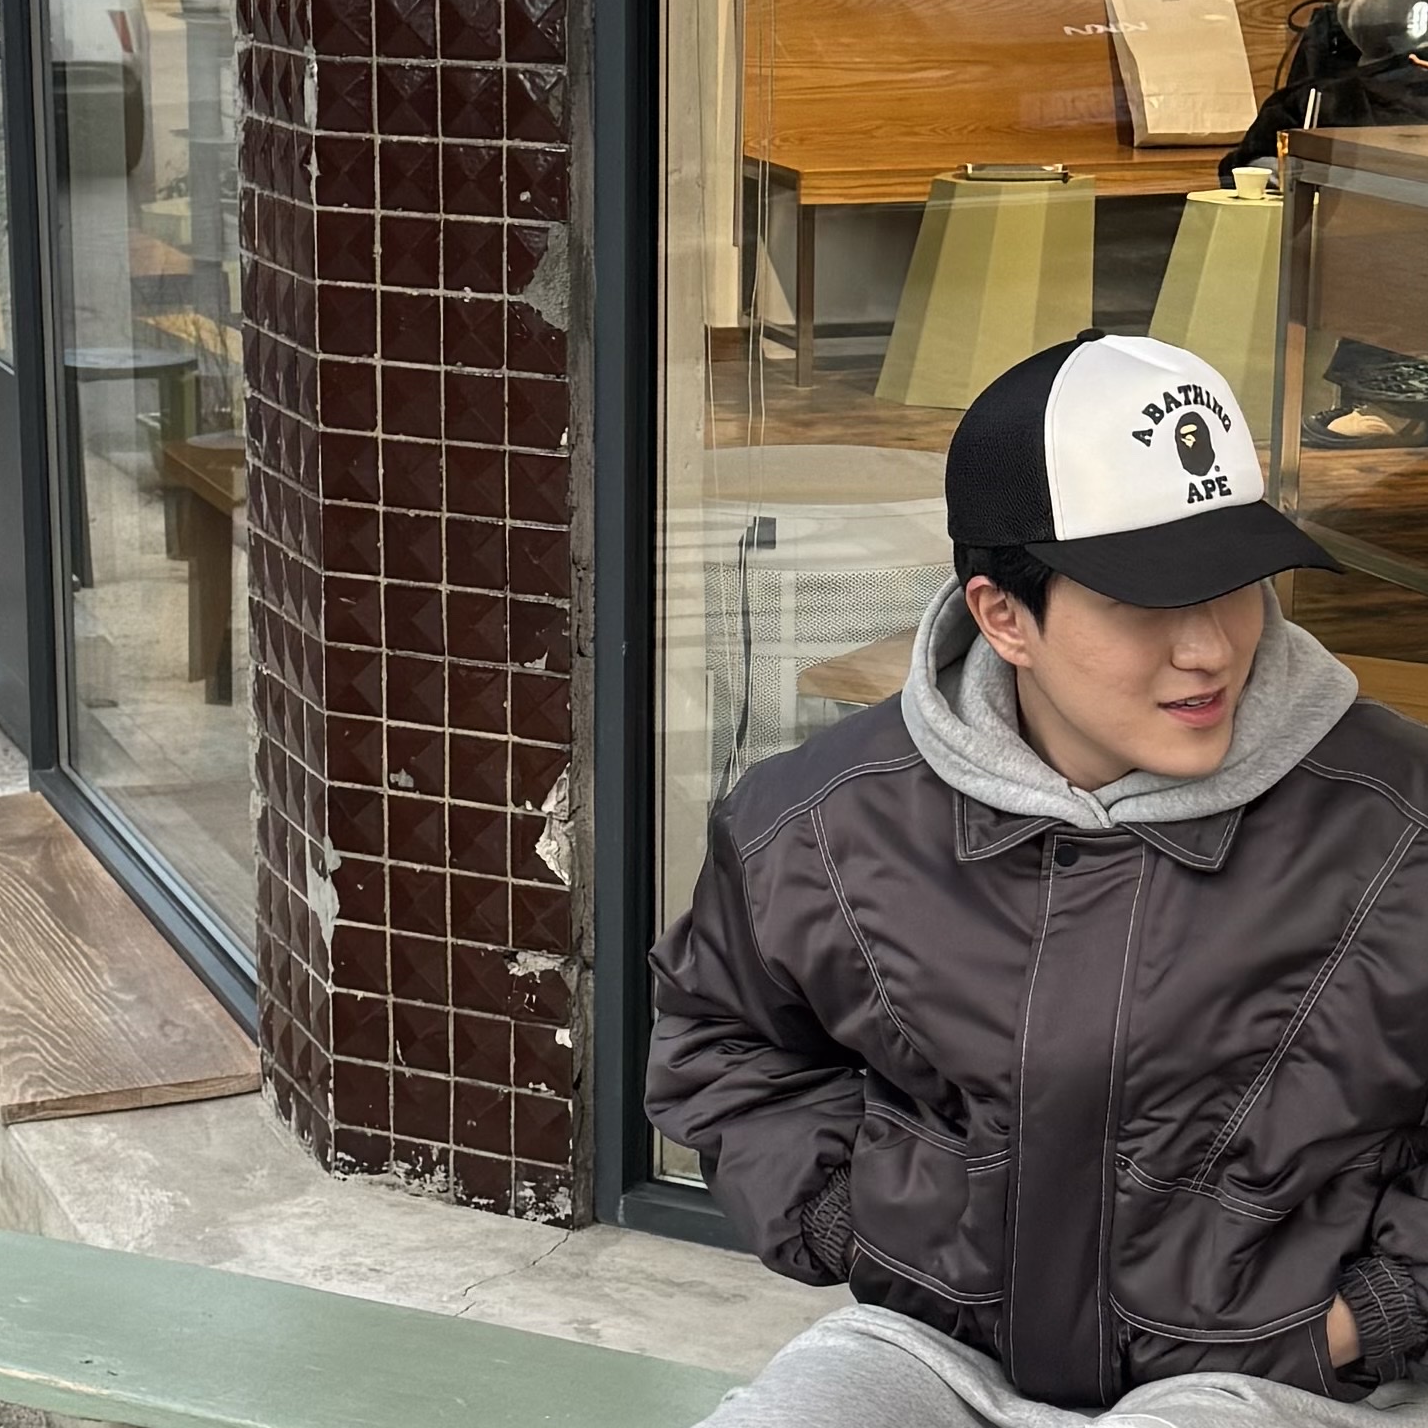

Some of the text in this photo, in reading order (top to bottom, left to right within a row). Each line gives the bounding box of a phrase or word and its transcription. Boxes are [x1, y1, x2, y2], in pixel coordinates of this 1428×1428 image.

[1132, 383, 1232, 448] A BATHING
[1187, 475, 1232, 504] APE
